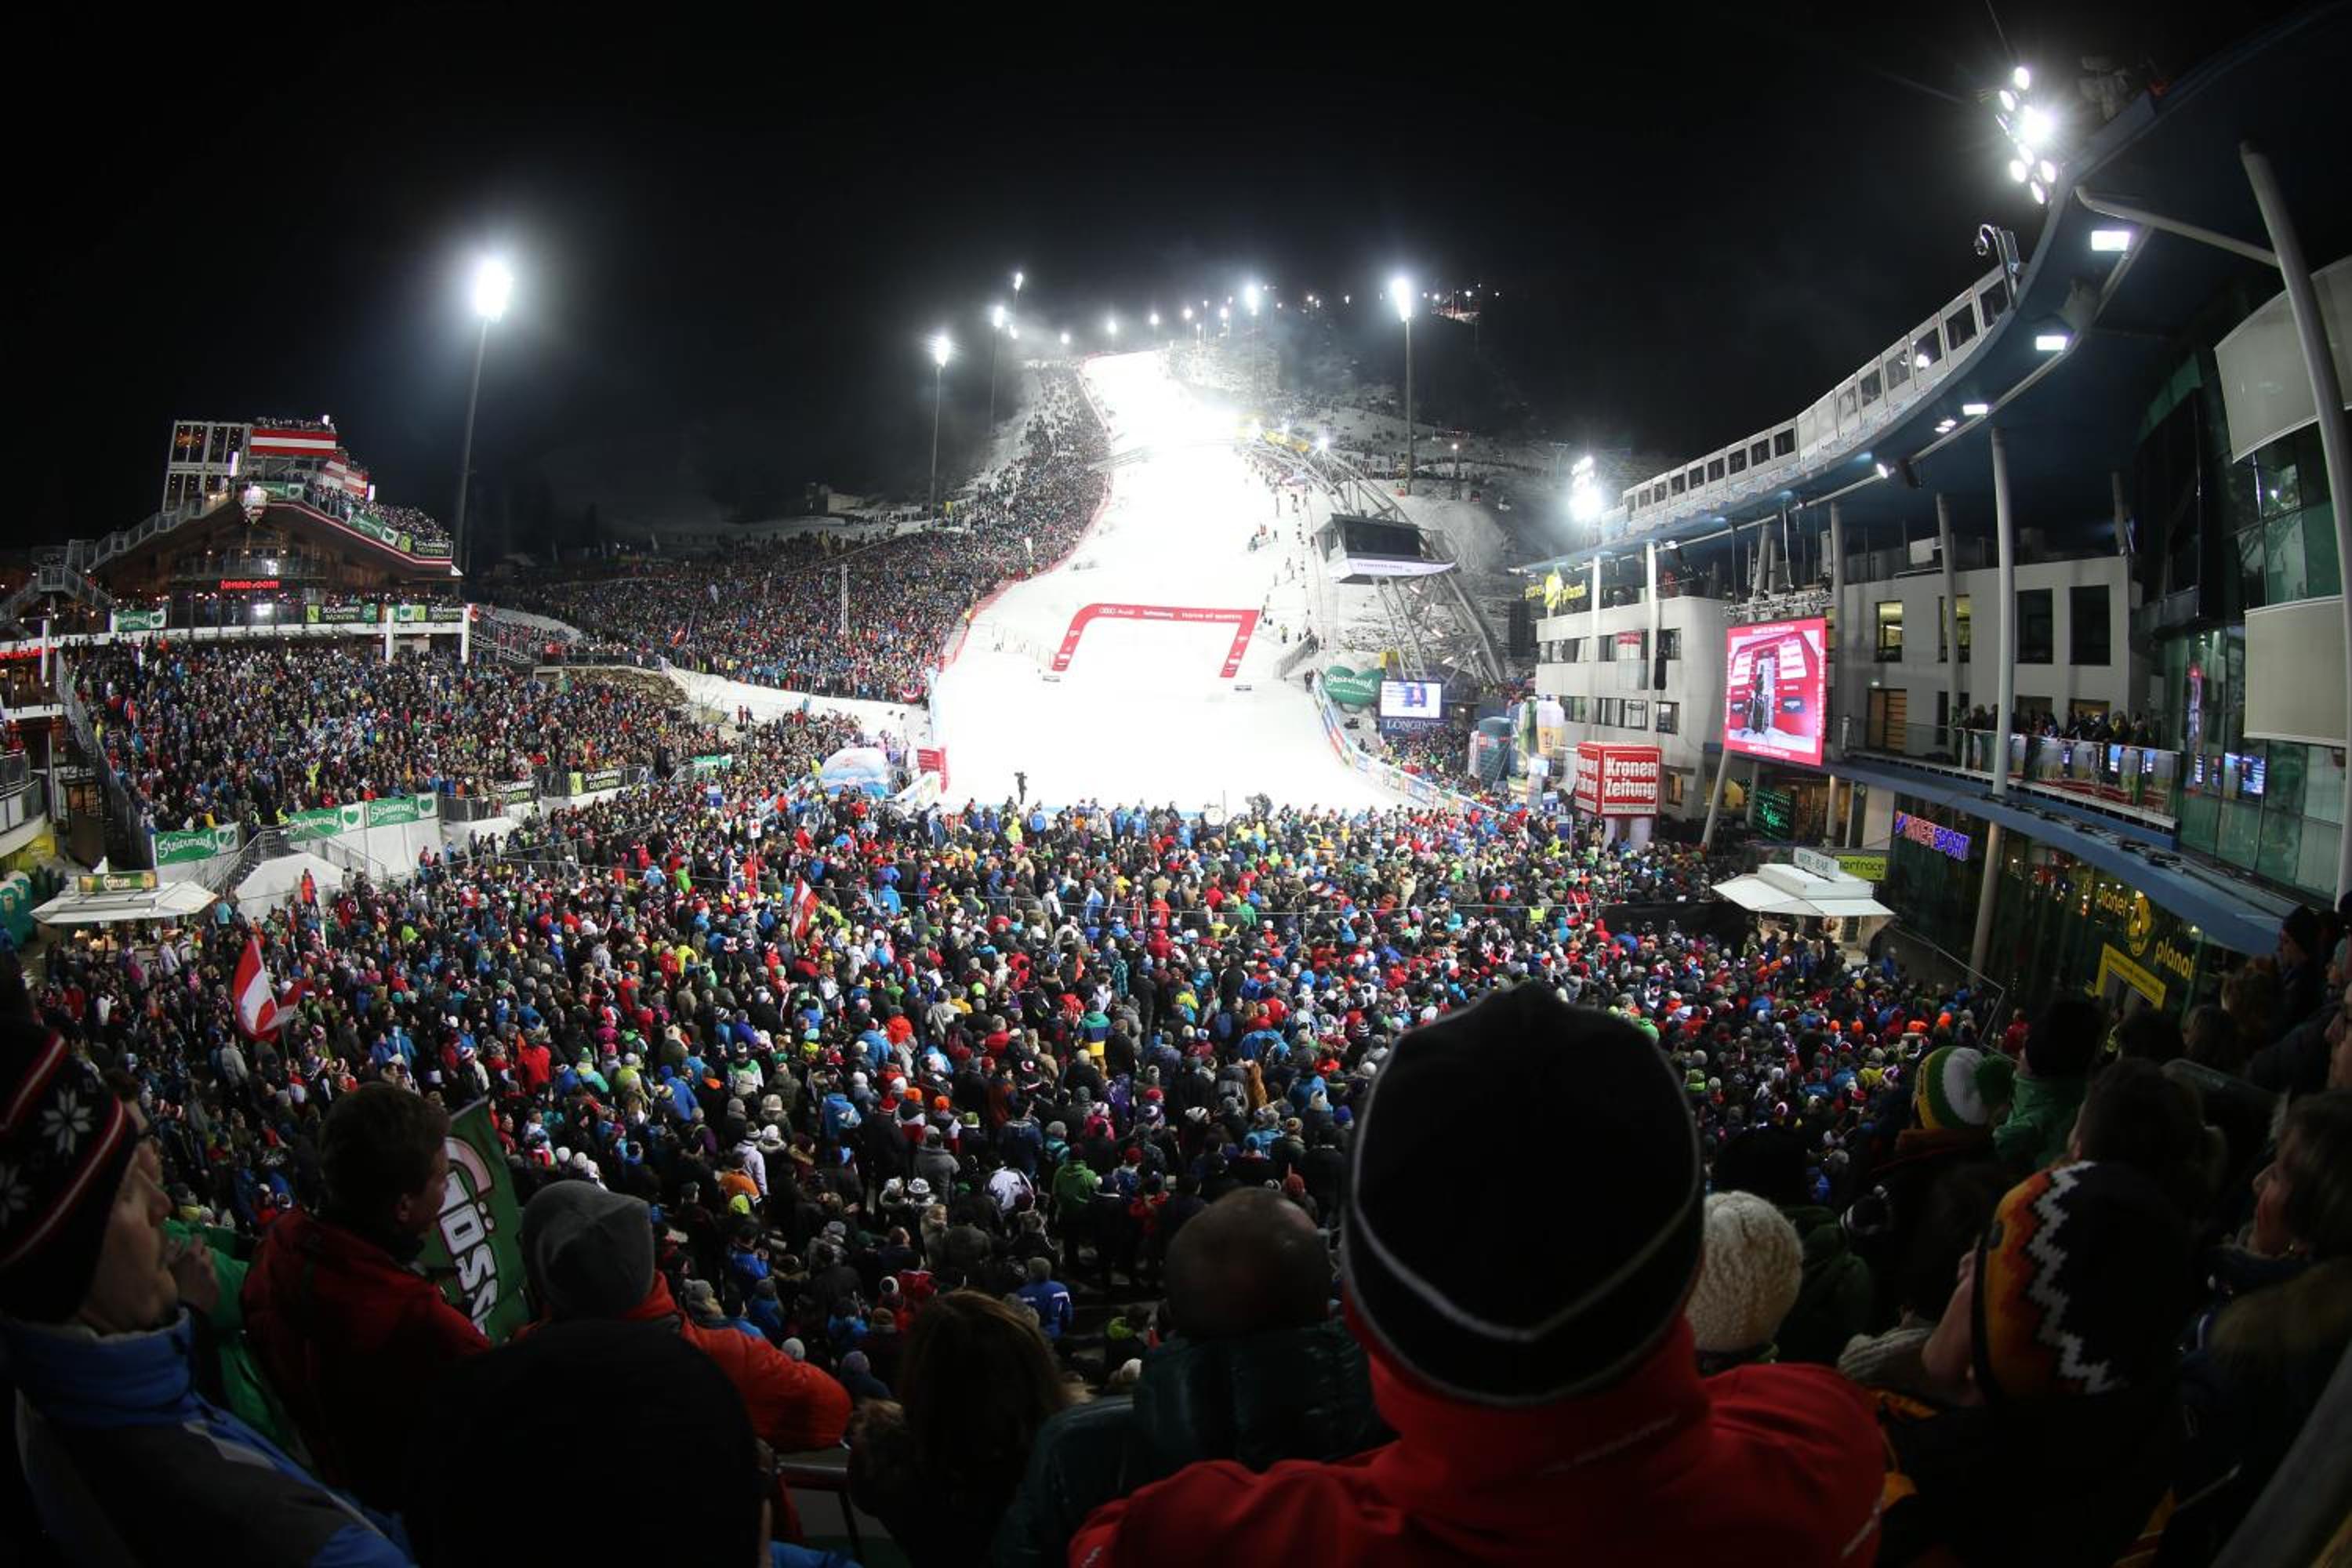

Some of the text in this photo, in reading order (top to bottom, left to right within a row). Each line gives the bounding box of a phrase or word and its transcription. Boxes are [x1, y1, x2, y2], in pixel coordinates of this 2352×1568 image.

[1605, 756, 1657, 777] Kronen
[1605, 777, 1657, 800] Zeitung
[370, 800, 418, 822] Steiermark
[158, 833, 216, 859] Steiermark
[1904, 815, 1970, 862] INTERSPORT
[2154, 935, 2196, 980] planai
